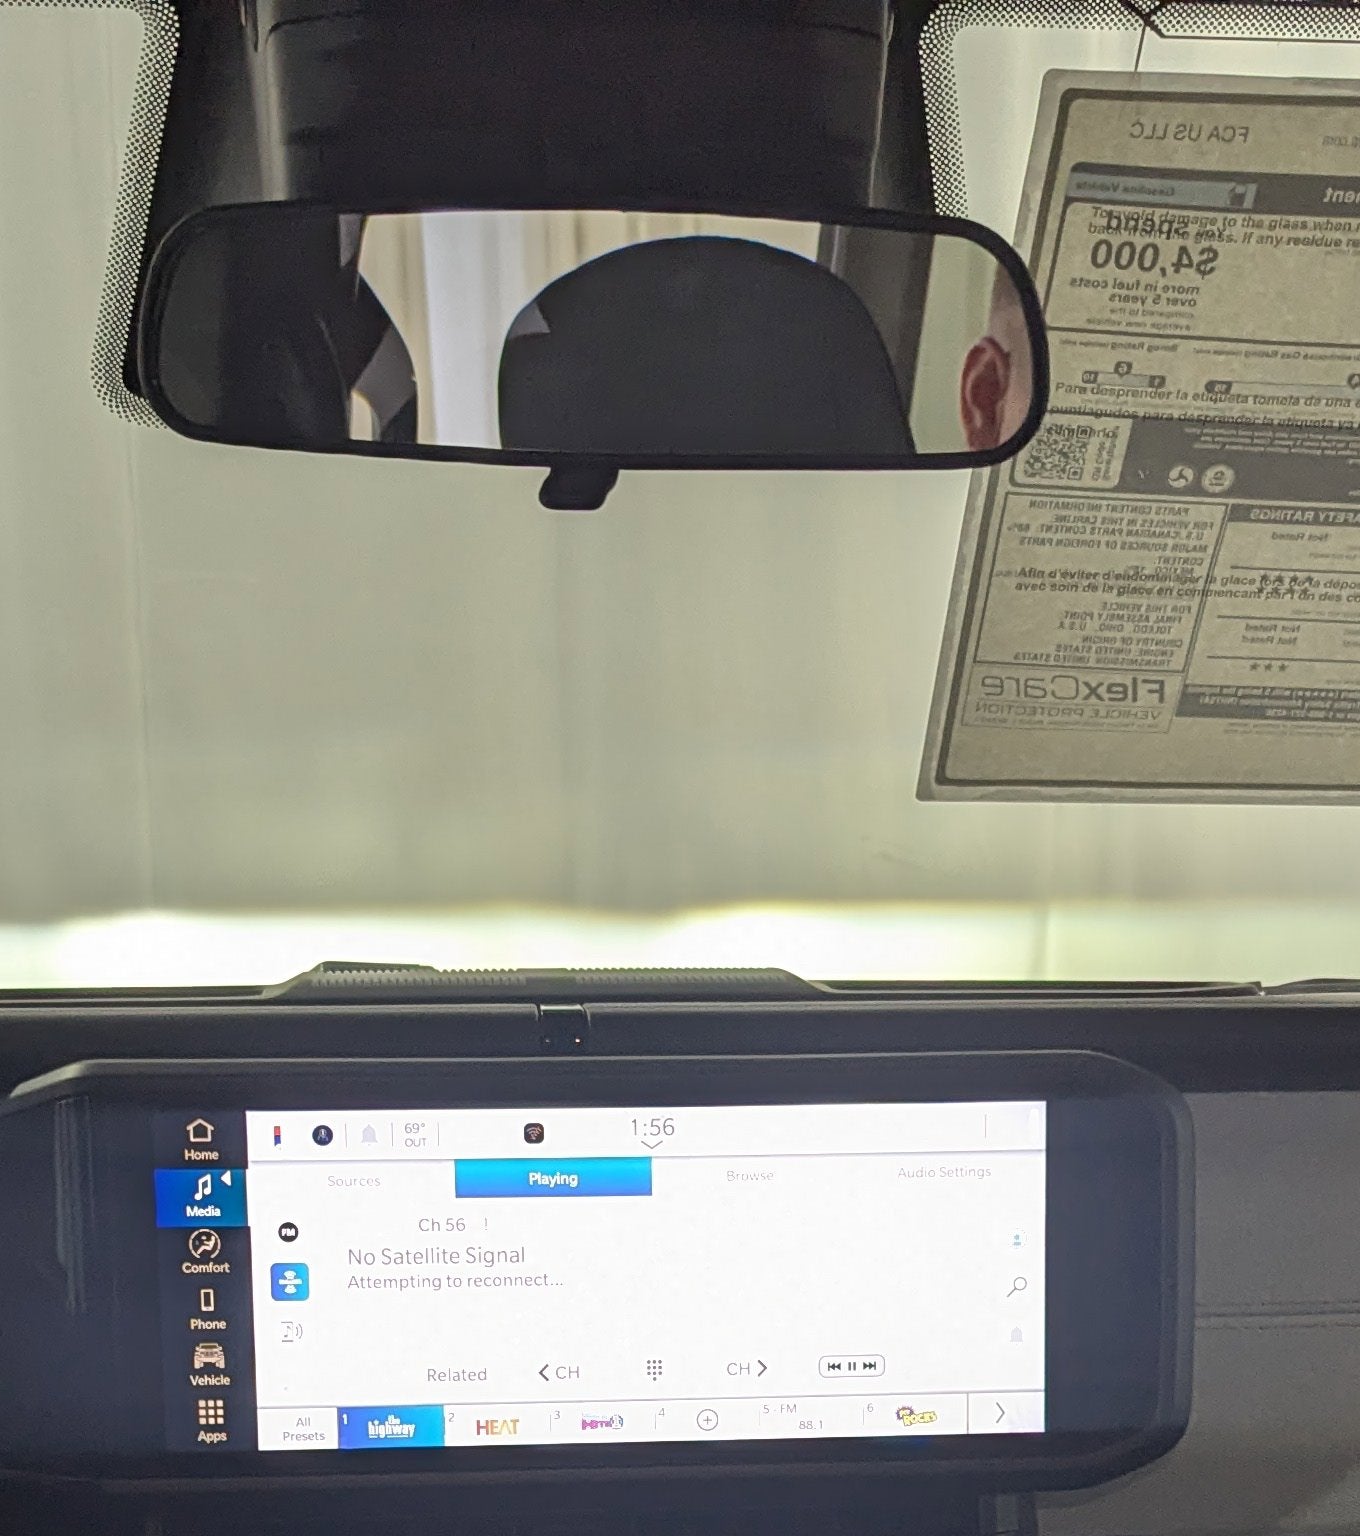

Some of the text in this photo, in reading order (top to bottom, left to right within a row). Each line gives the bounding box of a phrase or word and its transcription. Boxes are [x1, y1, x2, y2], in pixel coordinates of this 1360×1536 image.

[1266, 218, 1302, 236] glass
[1312, 219, 1352, 233] when
[631, 1117, 676, 1138] 1:56
[403, 1137, 428, 1149] OUT
[184, 1149, 219, 1161] Home
[527, 1171, 579, 1188] Playing
[725, 1169, 776, 1183] Browse
[896, 1165, 992, 1181] Audio Settings
[326, 1174, 382, 1188] Sources
[185, 1205, 221, 1218] Media
[418, 1217, 467, 1232] Ch 56
[347, 1246, 526, 1269] No Satellite Signal
[181, 1261, 231, 1274] Comfort
[347, 1273, 564, 1292] Attempting to reconnect...
[189, 1318, 227, 1331] Phone
[426, 1367, 488, 1382] Related
[554, 1365, 580, 1380] CH
[726, 1362, 752, 1376] CH
[189, 1374, 231, 1387] Vehicle
[657, 1407, 666, 1418] 4
[762, 1402, 798, 1414] 5 FM
[866, 1402, 875, 1413] 6
[342, 1413, 349, 1425] 1
[448, 1412, 456, 1423] 2
[553, 1409, 562, 1420] 3
[295, 1416, 312, 1428] All
[476, 1418, 520, 1436] HEAT
[797, 1419, 824, 1431] 88.1
[367, 1420, 416, 1439] highway
[197, 1431, 228, 1443] Apps
[282, 1430, 326, 1445] Presets
